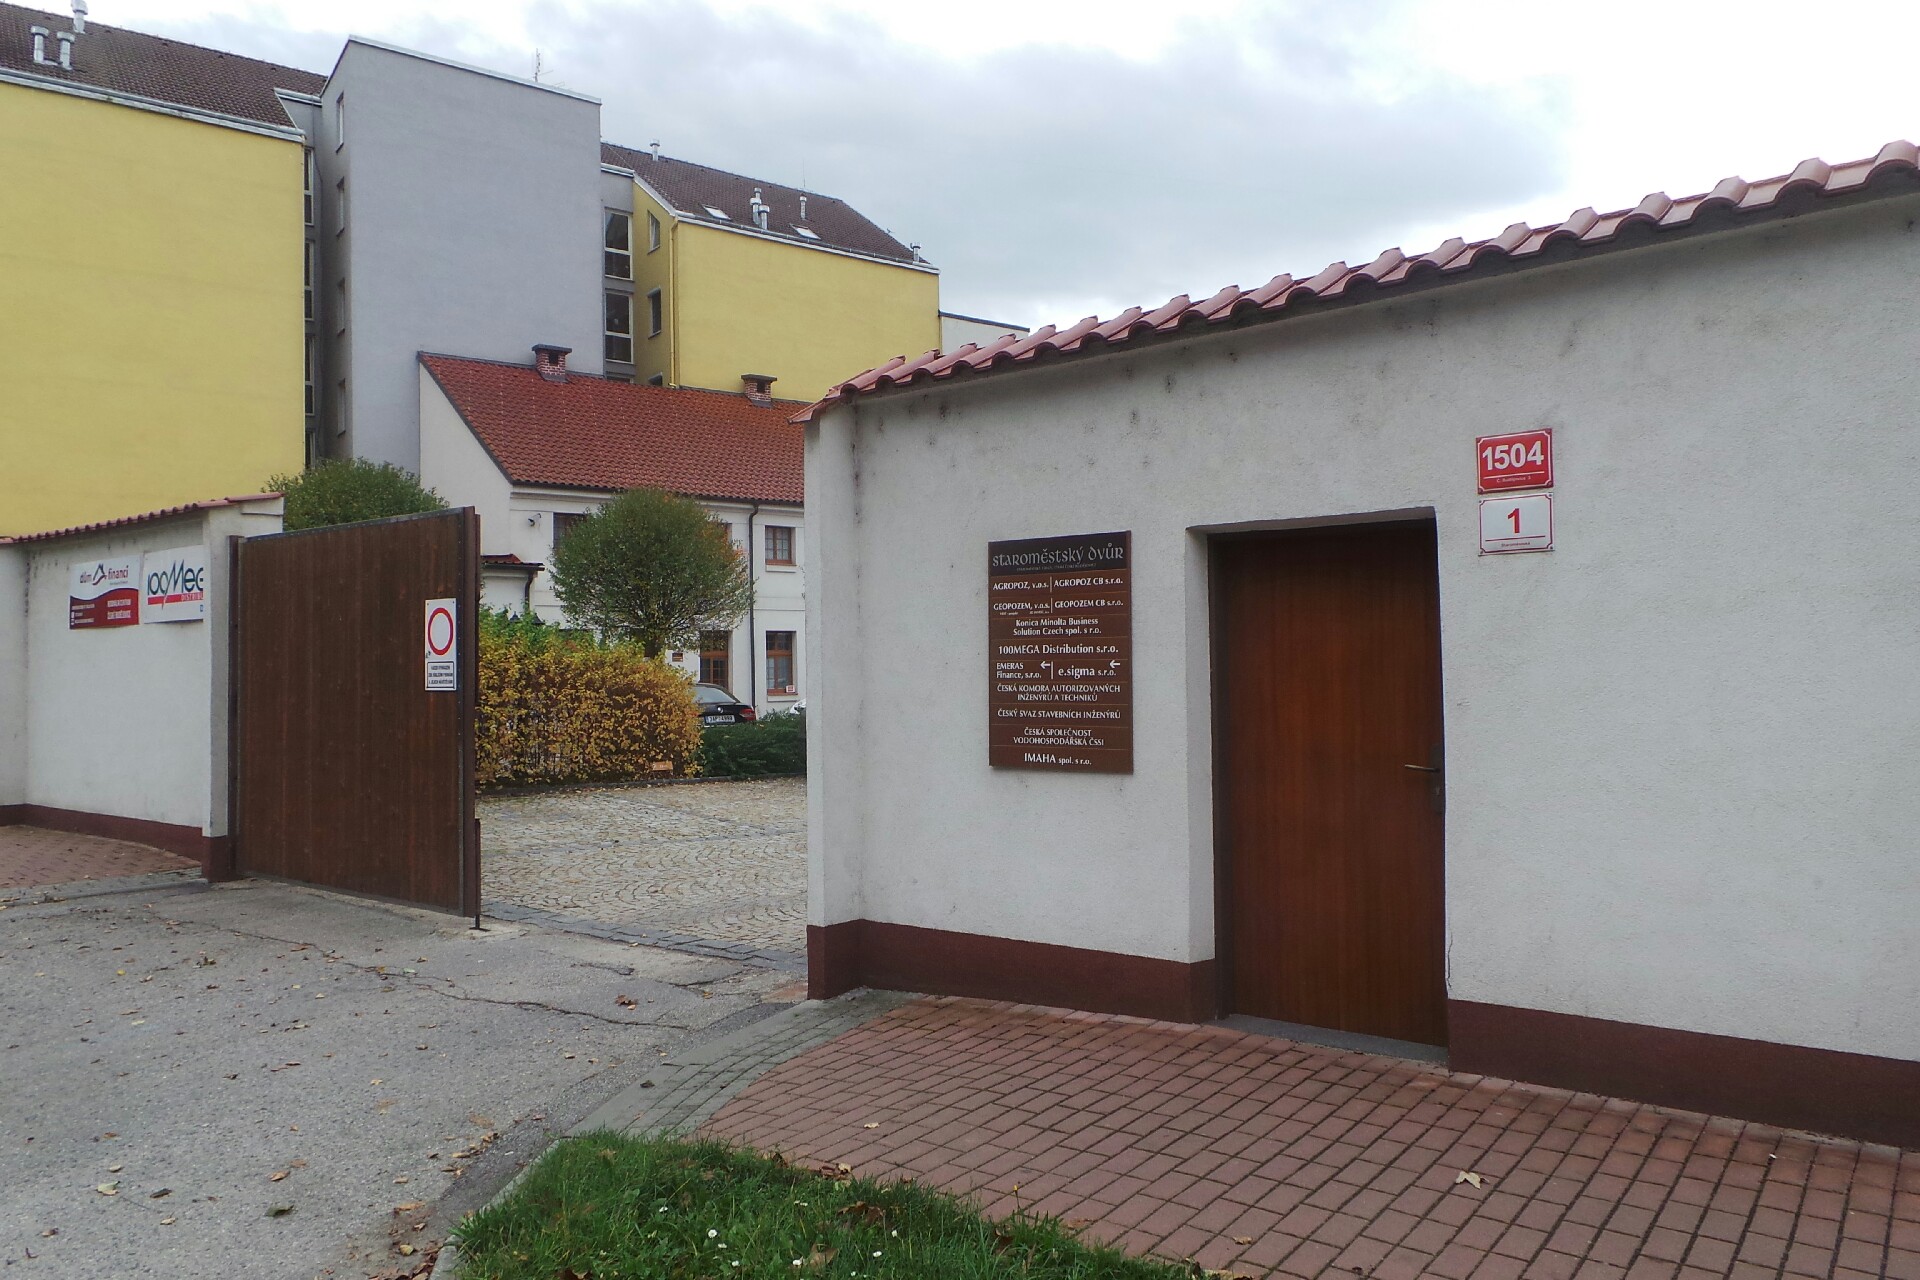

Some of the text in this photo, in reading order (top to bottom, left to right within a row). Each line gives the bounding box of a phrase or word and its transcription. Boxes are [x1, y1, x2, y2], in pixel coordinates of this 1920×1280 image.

[1482, 440, 1545, 471] 1504
[1507, 508, 1521, 534] 1
[993, 581, 1031, 591] AGROPOZ,
[1053, 576, 1123, 588] AGROPOZ CB s.r.o.
[993, 602, 1033, 611] GEOPOZEM,
[1054, 599, 1094, 609] GEOPOZEM
[1095, 598, 1106, 607] CB
[1015, 616, 1099, 627] Konica Minolta Business
[1013, 628, 1041, 636] Solution
[1042, 626, 1064, 635] Czech
[1065, 625, 1082, 636] spol.
[998, 643, 1119, 655] 100MEGA Distribution s.r.o.
[996, 662, 1024, 670] EMERAS
[996, 670, 1024, 680] Finance,
[1058, 665, 1095, 679] e.sigma
[997, 682, 1121, 693] ČESKÁ KOMORA AUTORIZOVANÝCH
[997, 707, 1018, 718] ČESKÝ
[1019, 710, 1037, 718] SVAZ
[1038, 709, 1082, 719] STAVEBNÍCH
[1024, 726, 1092, 737] ČESKÁ SPOLEČNOST
[1024, 752, 1057, 764] IMAHA
[1058, 756, 1074, 766] spol.
[1080, 758, 1092, 766] r.o.
